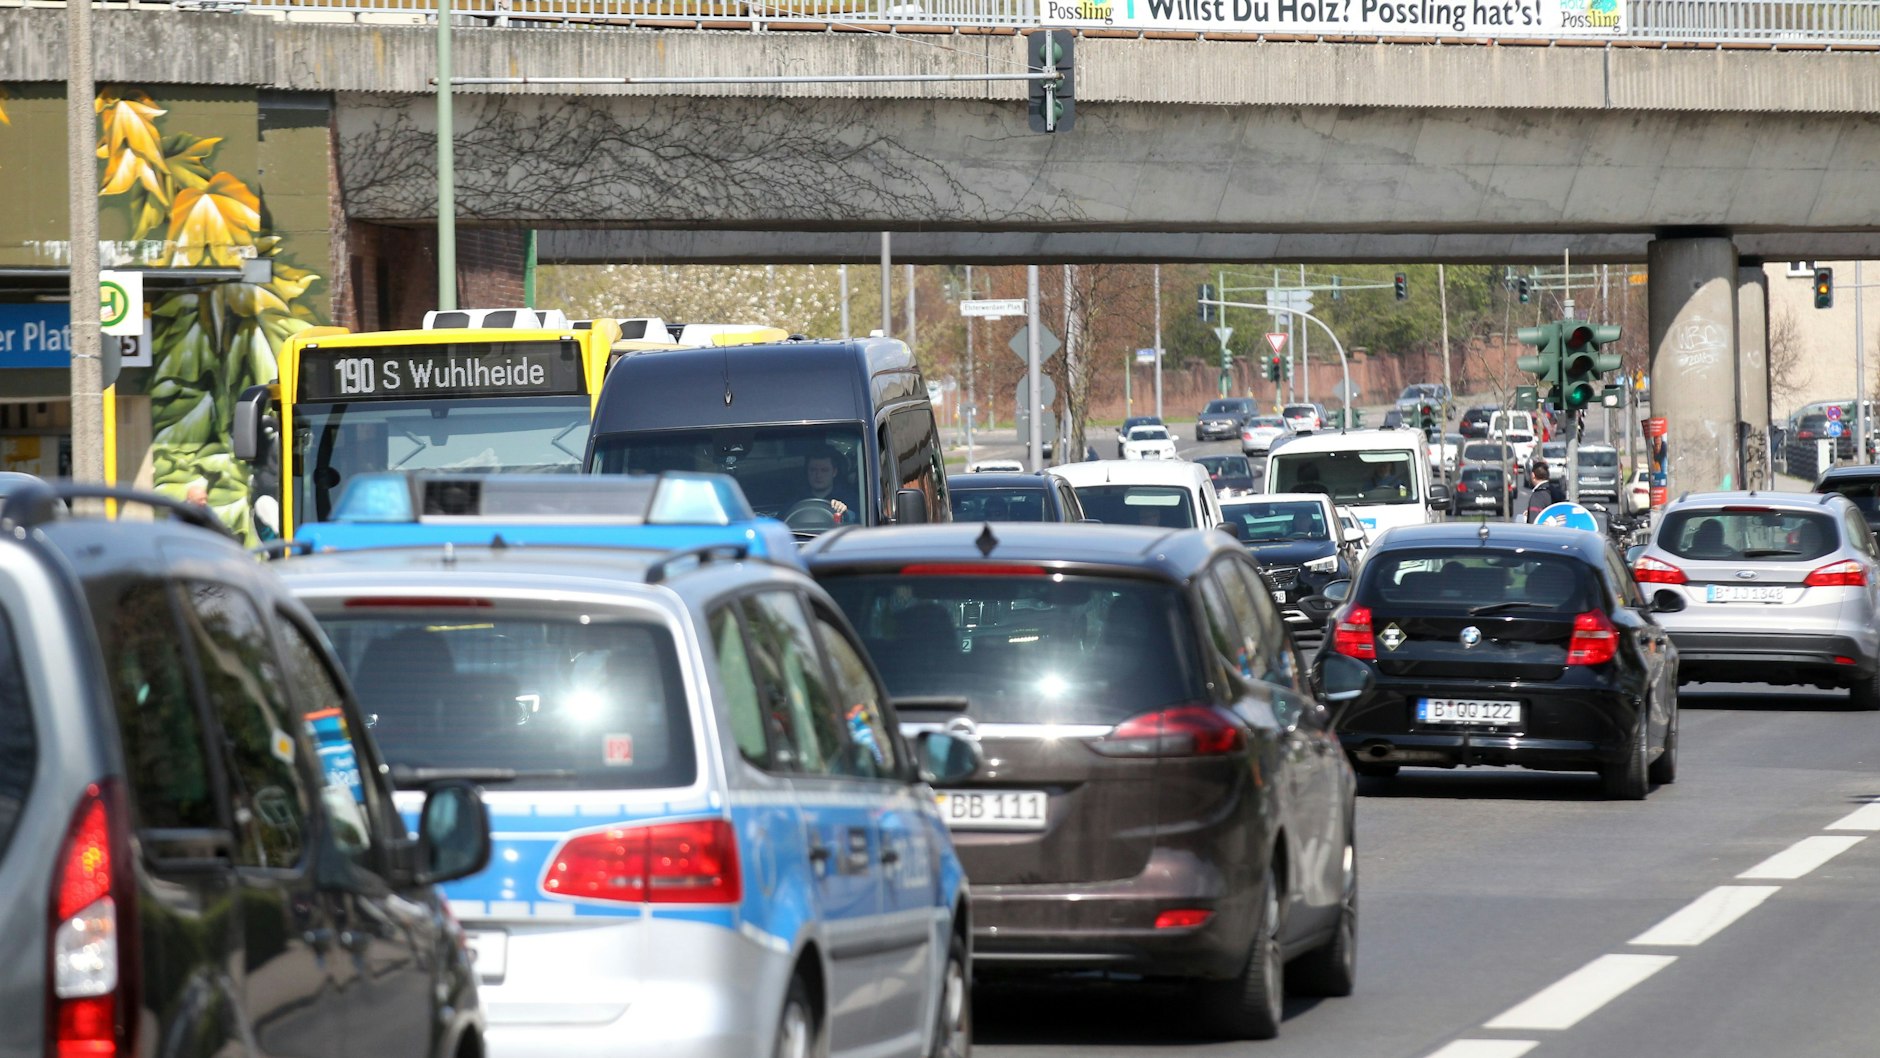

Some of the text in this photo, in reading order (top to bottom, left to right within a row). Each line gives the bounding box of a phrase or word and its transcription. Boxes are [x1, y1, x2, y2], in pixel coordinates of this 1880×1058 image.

[1048, 2, 1113, 25] Possling
[1148, 0, 1542, 31] Willst Du Holz? Possling hat's!
[1560, 10, 1622, 33] Possling
[23, 320, 72, 352] Plat
[334, 356, 545, 394] 190 S Wuhlheide
[1716, 587, 1724, 599] B
[1435, 702, 1444, 717] B
[1483, 703, 1513, 719] 122
[951, 794, 1042, 819] BB 111
